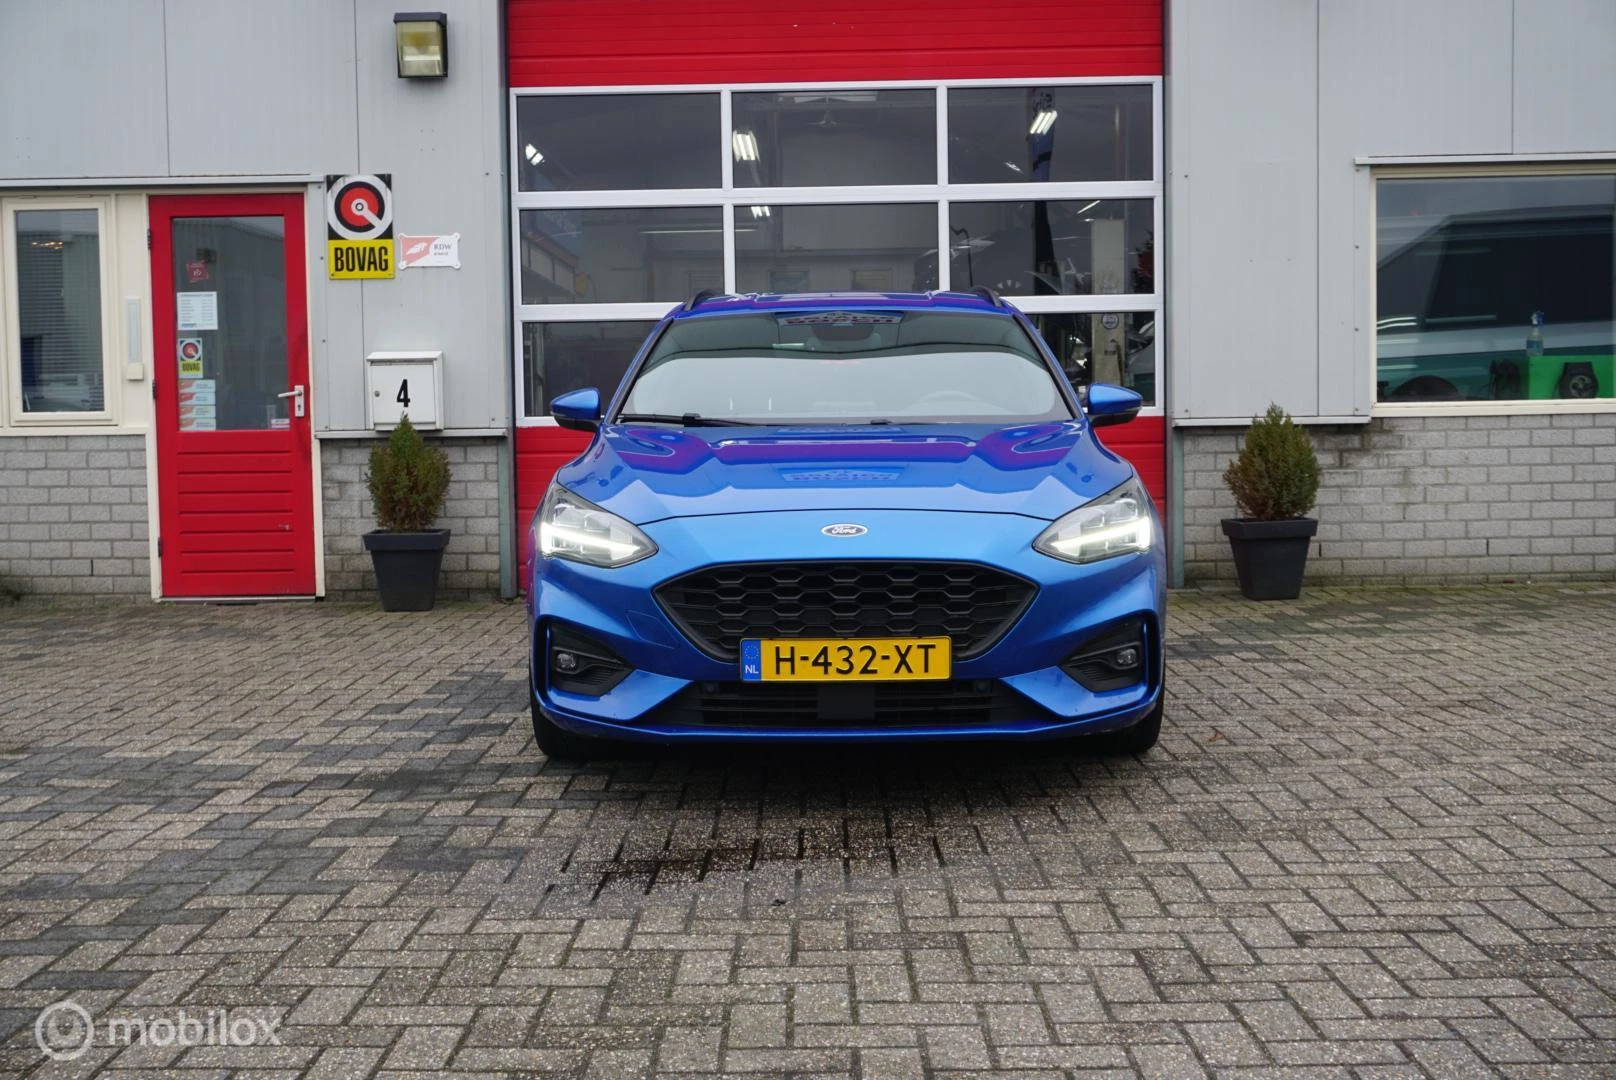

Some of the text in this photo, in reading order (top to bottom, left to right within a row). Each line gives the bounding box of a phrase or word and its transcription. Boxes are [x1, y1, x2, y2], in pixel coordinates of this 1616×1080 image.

[334, 246, 389, 272] BOVAG
[396, 378, 411, 408] 4
[745, 664, 760, 674] NL
[775, 644, 936, 675] H-432-XT
